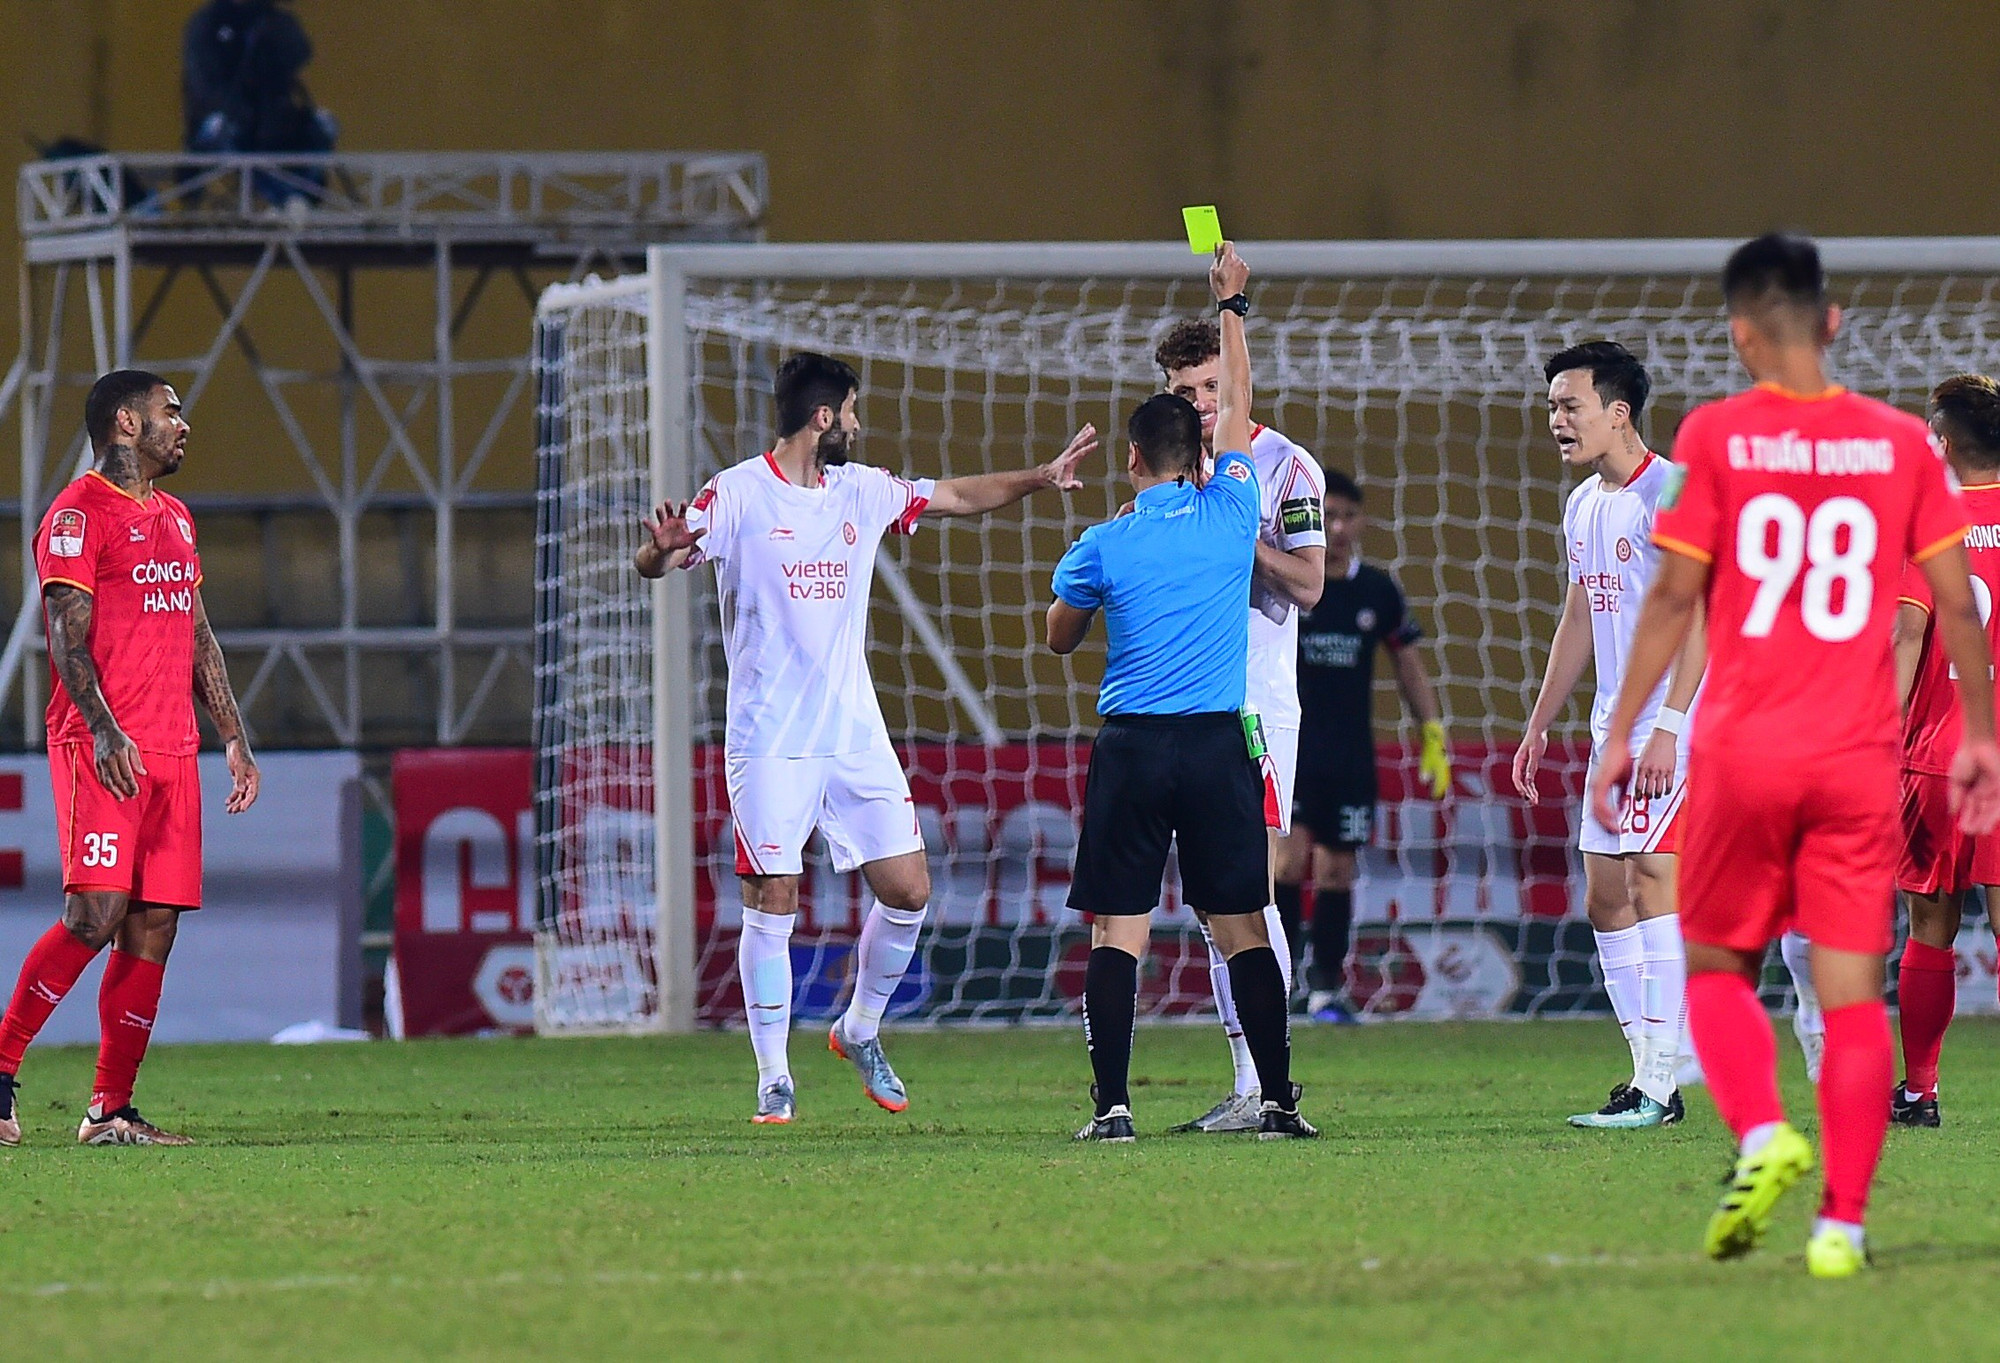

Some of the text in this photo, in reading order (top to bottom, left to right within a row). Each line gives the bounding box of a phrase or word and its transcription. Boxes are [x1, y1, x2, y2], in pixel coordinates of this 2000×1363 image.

[132, 559, 182, 584] CÔNG
[781, 560, 848, 578] viettel
[1736, 492, 1878, 642] 98
[144, 587, 170, 613] HÀ
[788, 581, 846, 599] tv360
[82, 832, 119, 868] 35
